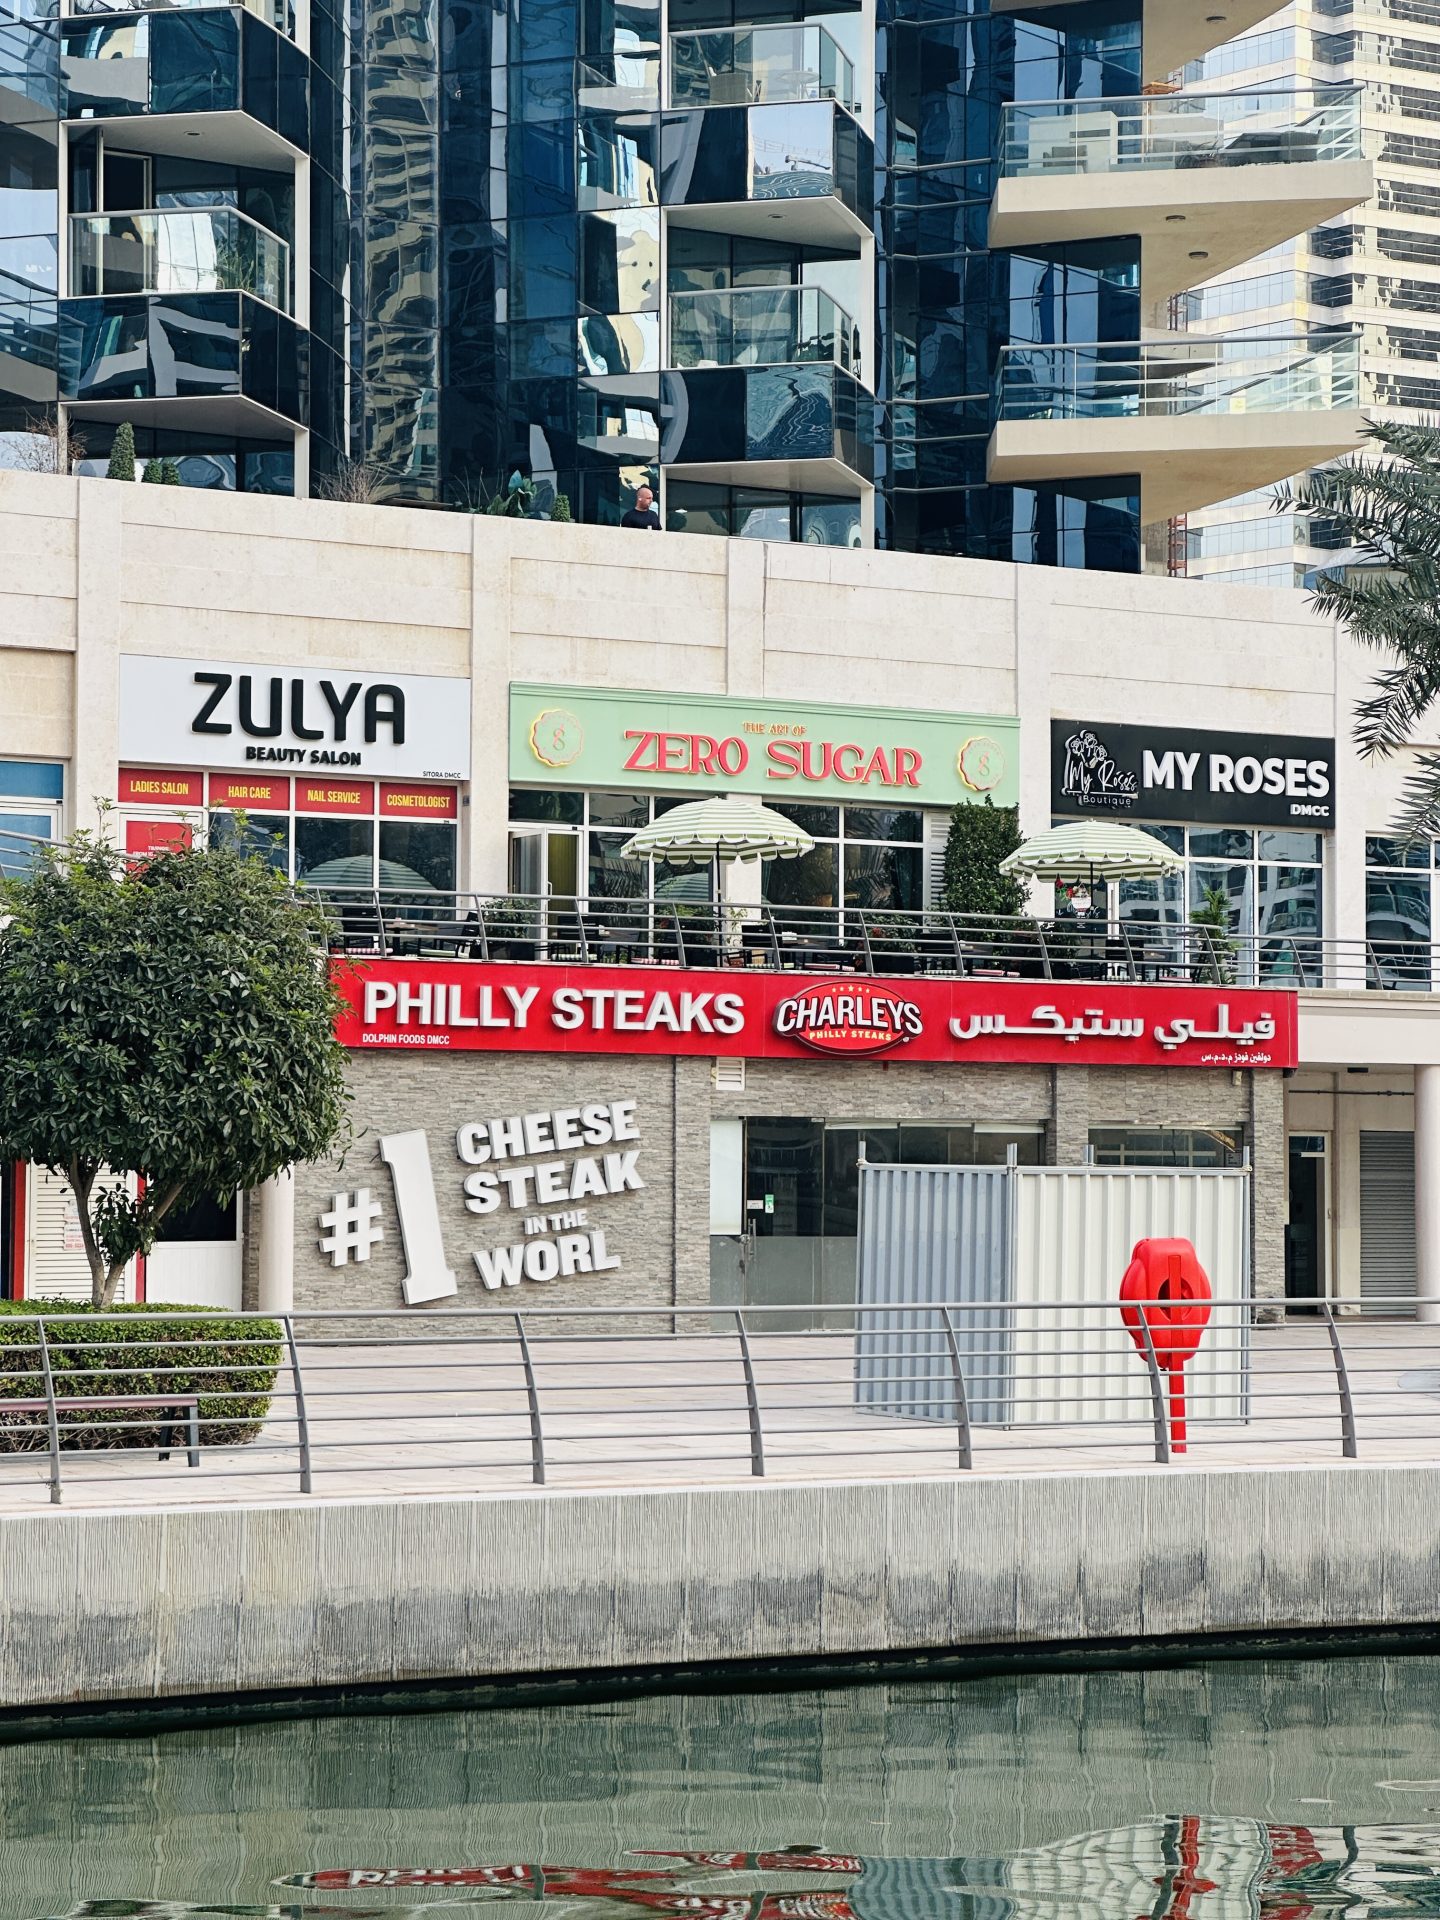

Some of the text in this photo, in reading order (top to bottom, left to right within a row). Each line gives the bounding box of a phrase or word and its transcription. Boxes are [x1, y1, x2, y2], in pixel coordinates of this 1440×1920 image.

[191, 672, 406, 745] ZULYA
[743, 722, 807, 736] THE ART OF
[246, 746, 361, 766] BEAUTY SALON
[623, 730, 923, 787] ZERO SUGAR
[423, 770, 443, 778] SITORA
[1069, 760, 1093, 794] My
[1143, 750, 1330, 798] MY ROSES
[130, 780, 189, 795] LADIES SALON
[228, 786, 271, 799] HAIR CARE
[307, 790, 360, 804] NAIL SERVICE
[387, 794, 450, 808] COSMETOLOGIST
[1083, 795, 1131, 805] Boutique
[1290, 804, 1330, 817] DMCC
[364, 981, 745, 1034] PHILLY STEAKS
[775, 995, 923, 1035] CHARLEYS
[809, 1030, 892, 1041] PHILLY STEAKS
[950, 1003, 1276, 1050] فيلي ستيكس
[362, 1033, 450, 1045] DOLPHIN FOODS DMCC
[1250, 1052, 1272, 1064] دولفين
[456, 1100, 641, 1164] CHEESE
[464, 1150, 648, 1214] STEAK
[524, 1208, 589, 1235] IN THE
[472, 1230, 622, 1290] WORL
